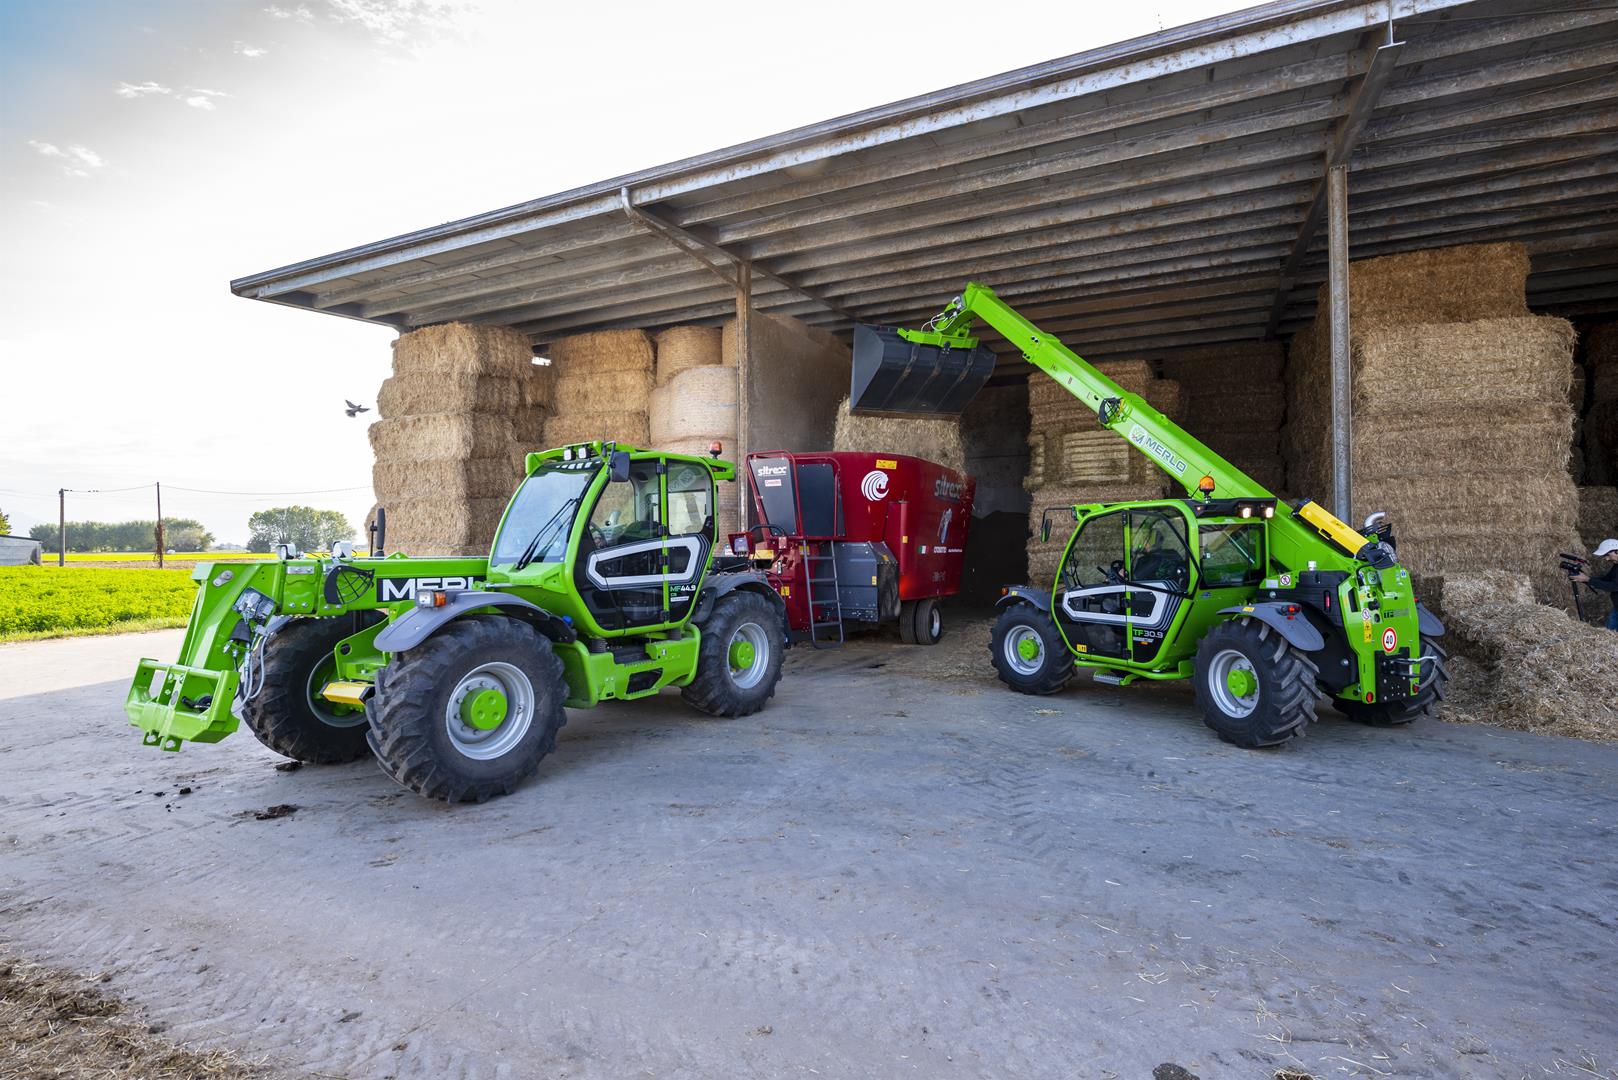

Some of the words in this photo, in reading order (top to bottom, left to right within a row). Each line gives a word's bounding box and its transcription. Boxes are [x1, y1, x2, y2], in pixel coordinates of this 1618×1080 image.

[1145, 437, 1187, 473] MERLO
[757, 465, 787, 477] sitrex
[670, 584, 696, 592] MF44.9
[1133, 629, 1164, 639] TF30.9
[1385, 634, 1394, 645] 40
